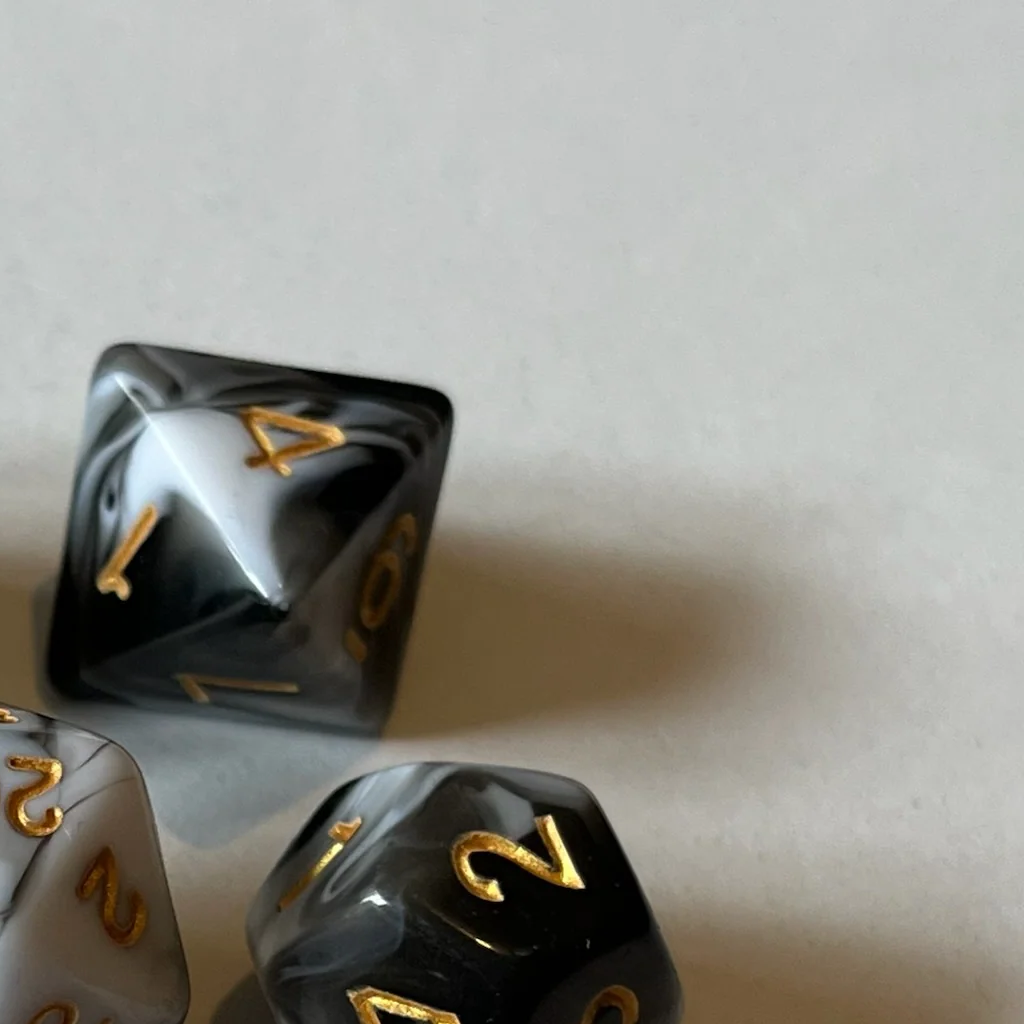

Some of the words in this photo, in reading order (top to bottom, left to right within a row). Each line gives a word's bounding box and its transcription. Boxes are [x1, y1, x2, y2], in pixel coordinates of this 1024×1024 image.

[240, 406, 347, 477] 4
[76, 845, 149, 949] 2
[451, 814, 586, 902] 2
